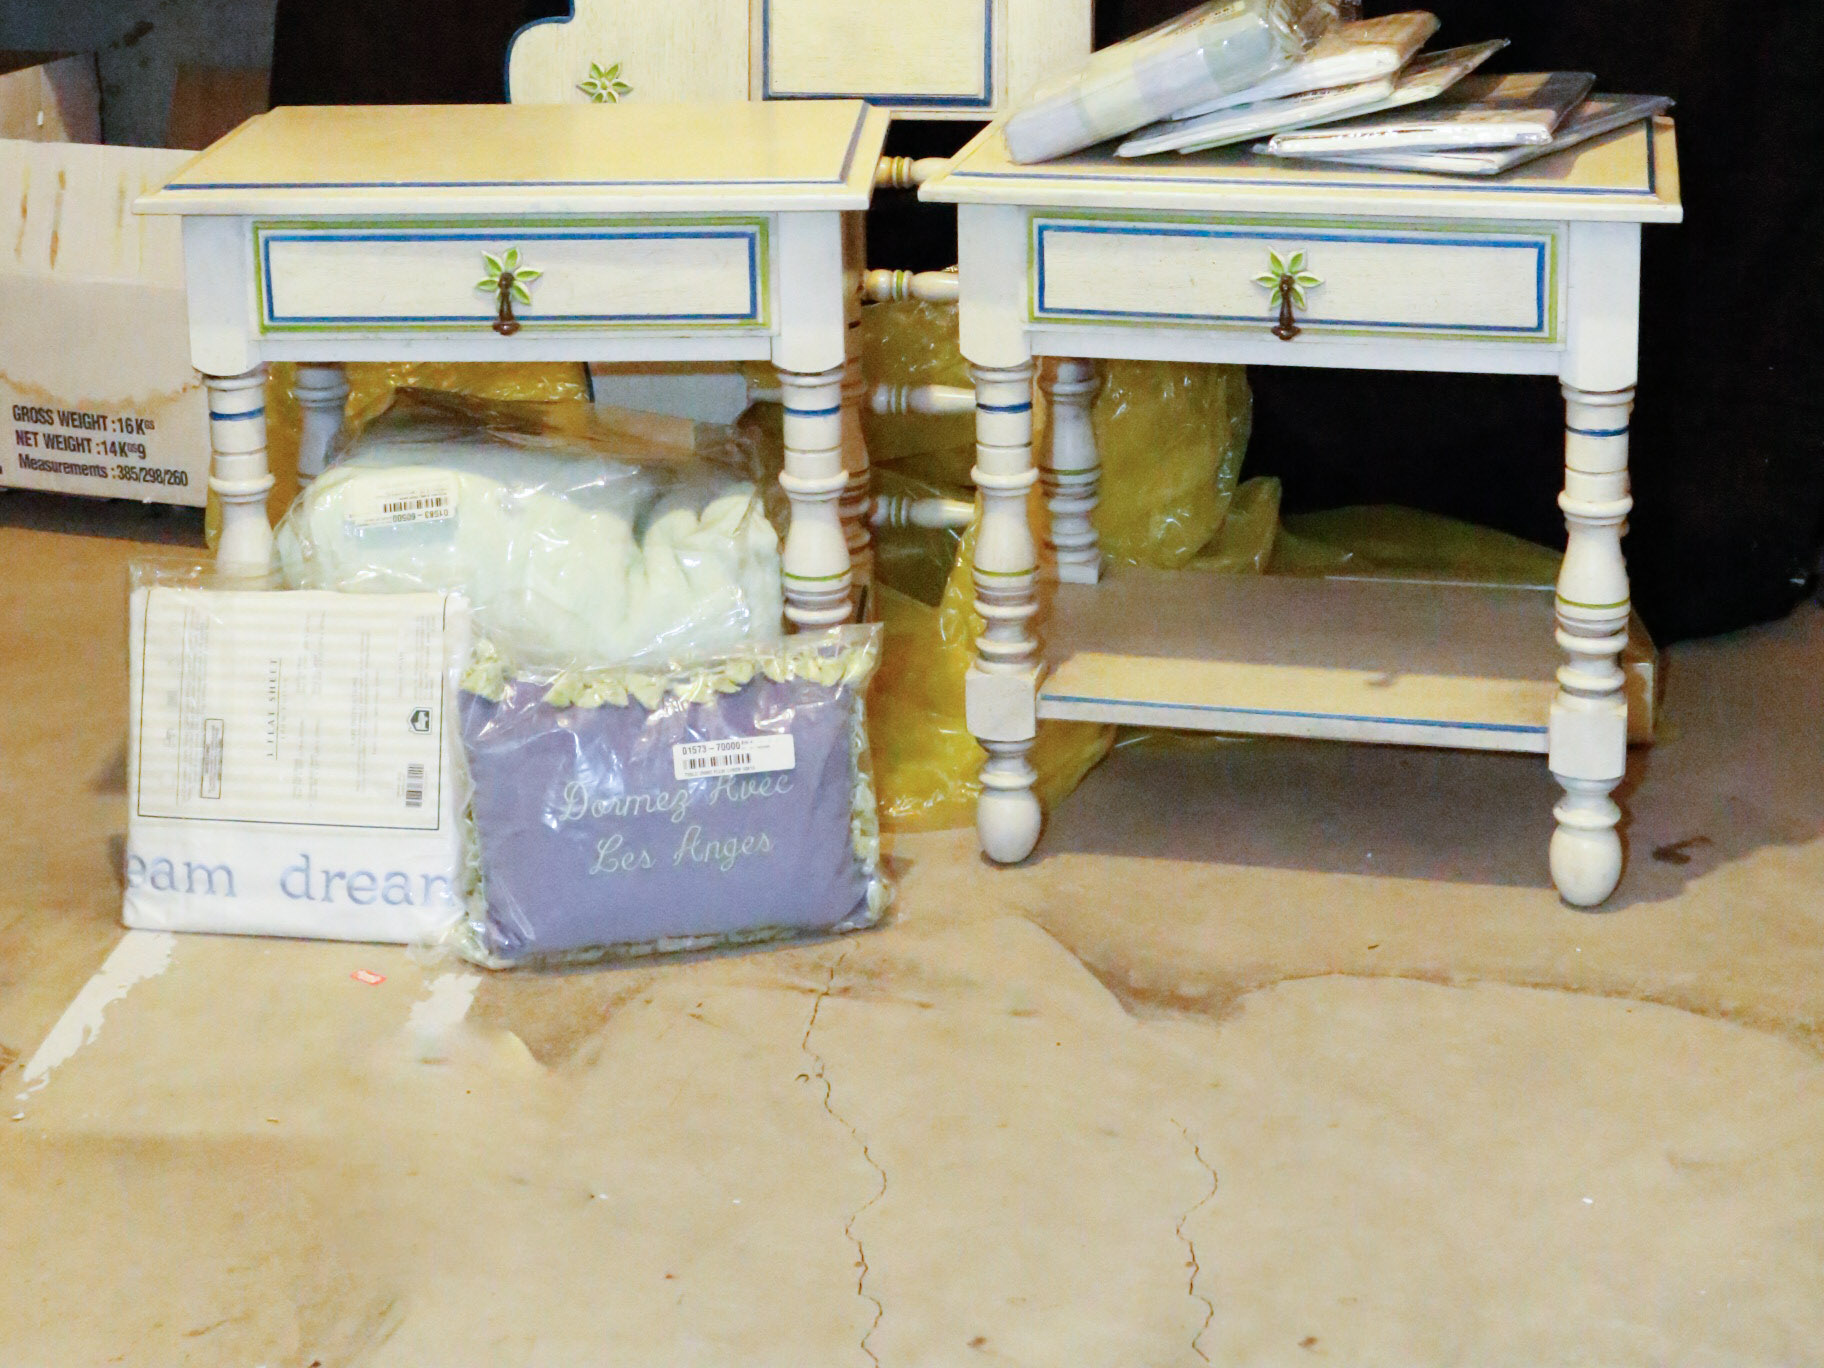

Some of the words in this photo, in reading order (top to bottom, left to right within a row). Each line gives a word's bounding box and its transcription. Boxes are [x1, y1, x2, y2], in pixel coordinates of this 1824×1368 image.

[12, 404, 54, 427] GROSS
[57, 409, 108, 432] WEIGHT
[15, 429, 39, 447] NET
[43, 433, 92, 454] WEIGHT
[18, 452, 109, 478] Measurements
[559, 780, 693, 823] Dormez
[709, 774, 793, 805] Avec
[589, 834, 656, 875] Les
[673, 825, 774, 872] Anges
